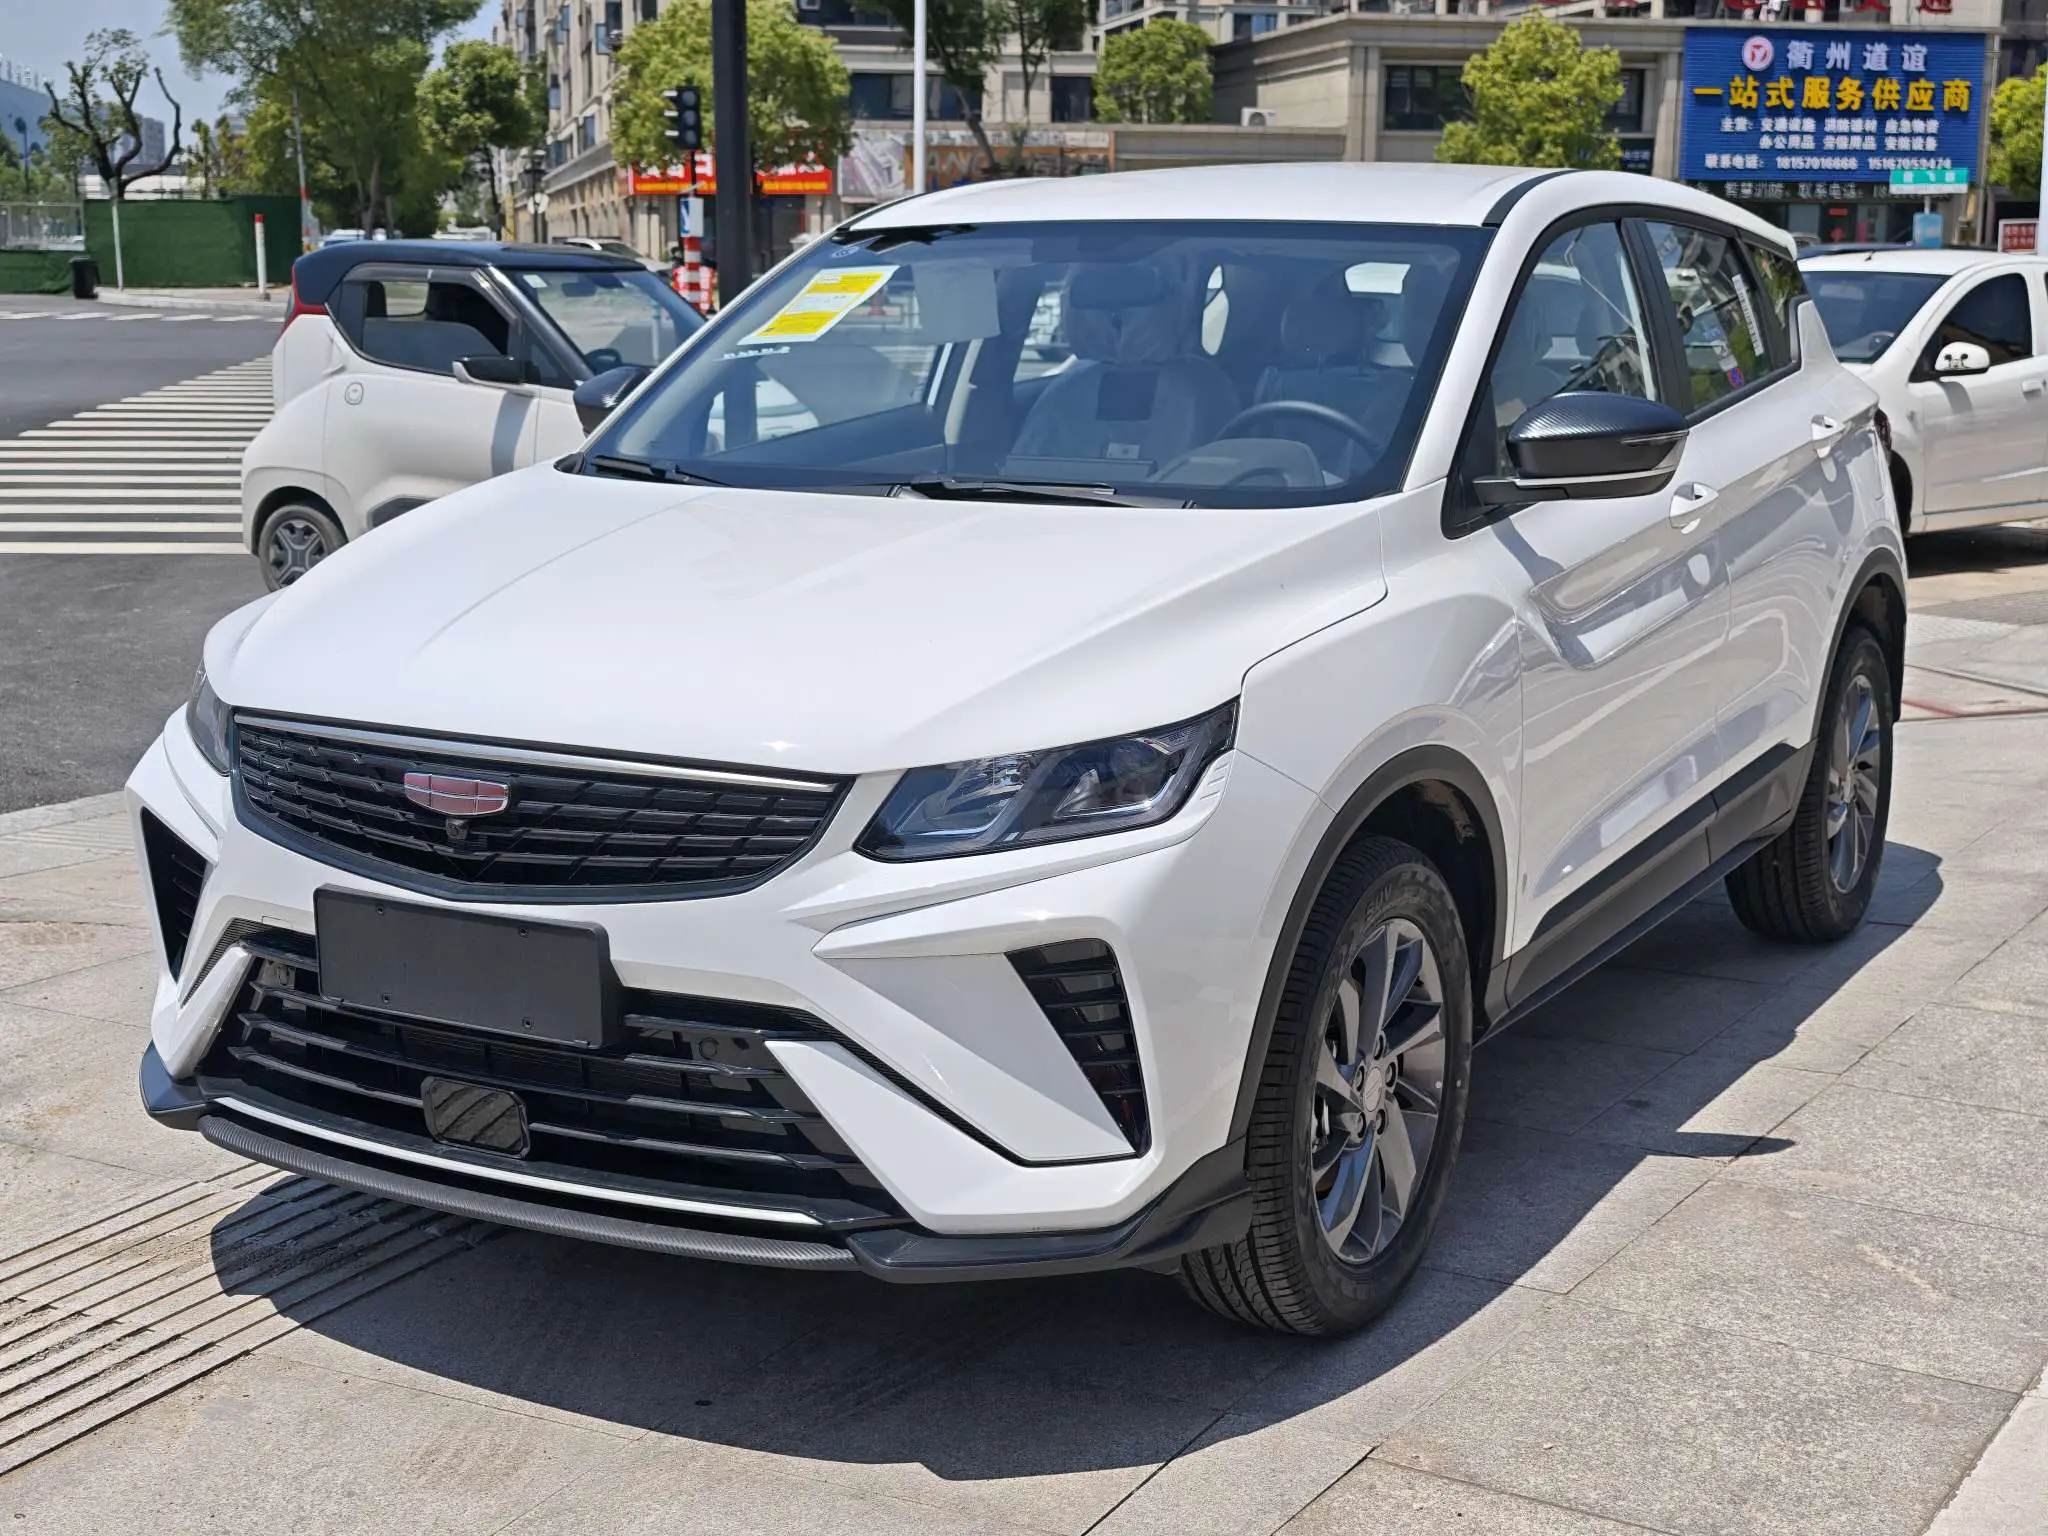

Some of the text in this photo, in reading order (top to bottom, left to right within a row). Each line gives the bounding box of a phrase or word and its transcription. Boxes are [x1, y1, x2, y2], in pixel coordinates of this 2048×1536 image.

[1693, 75, 1972, 112] 一站式服务供应商
[1759, 134, 1815, 150] 办公用品
